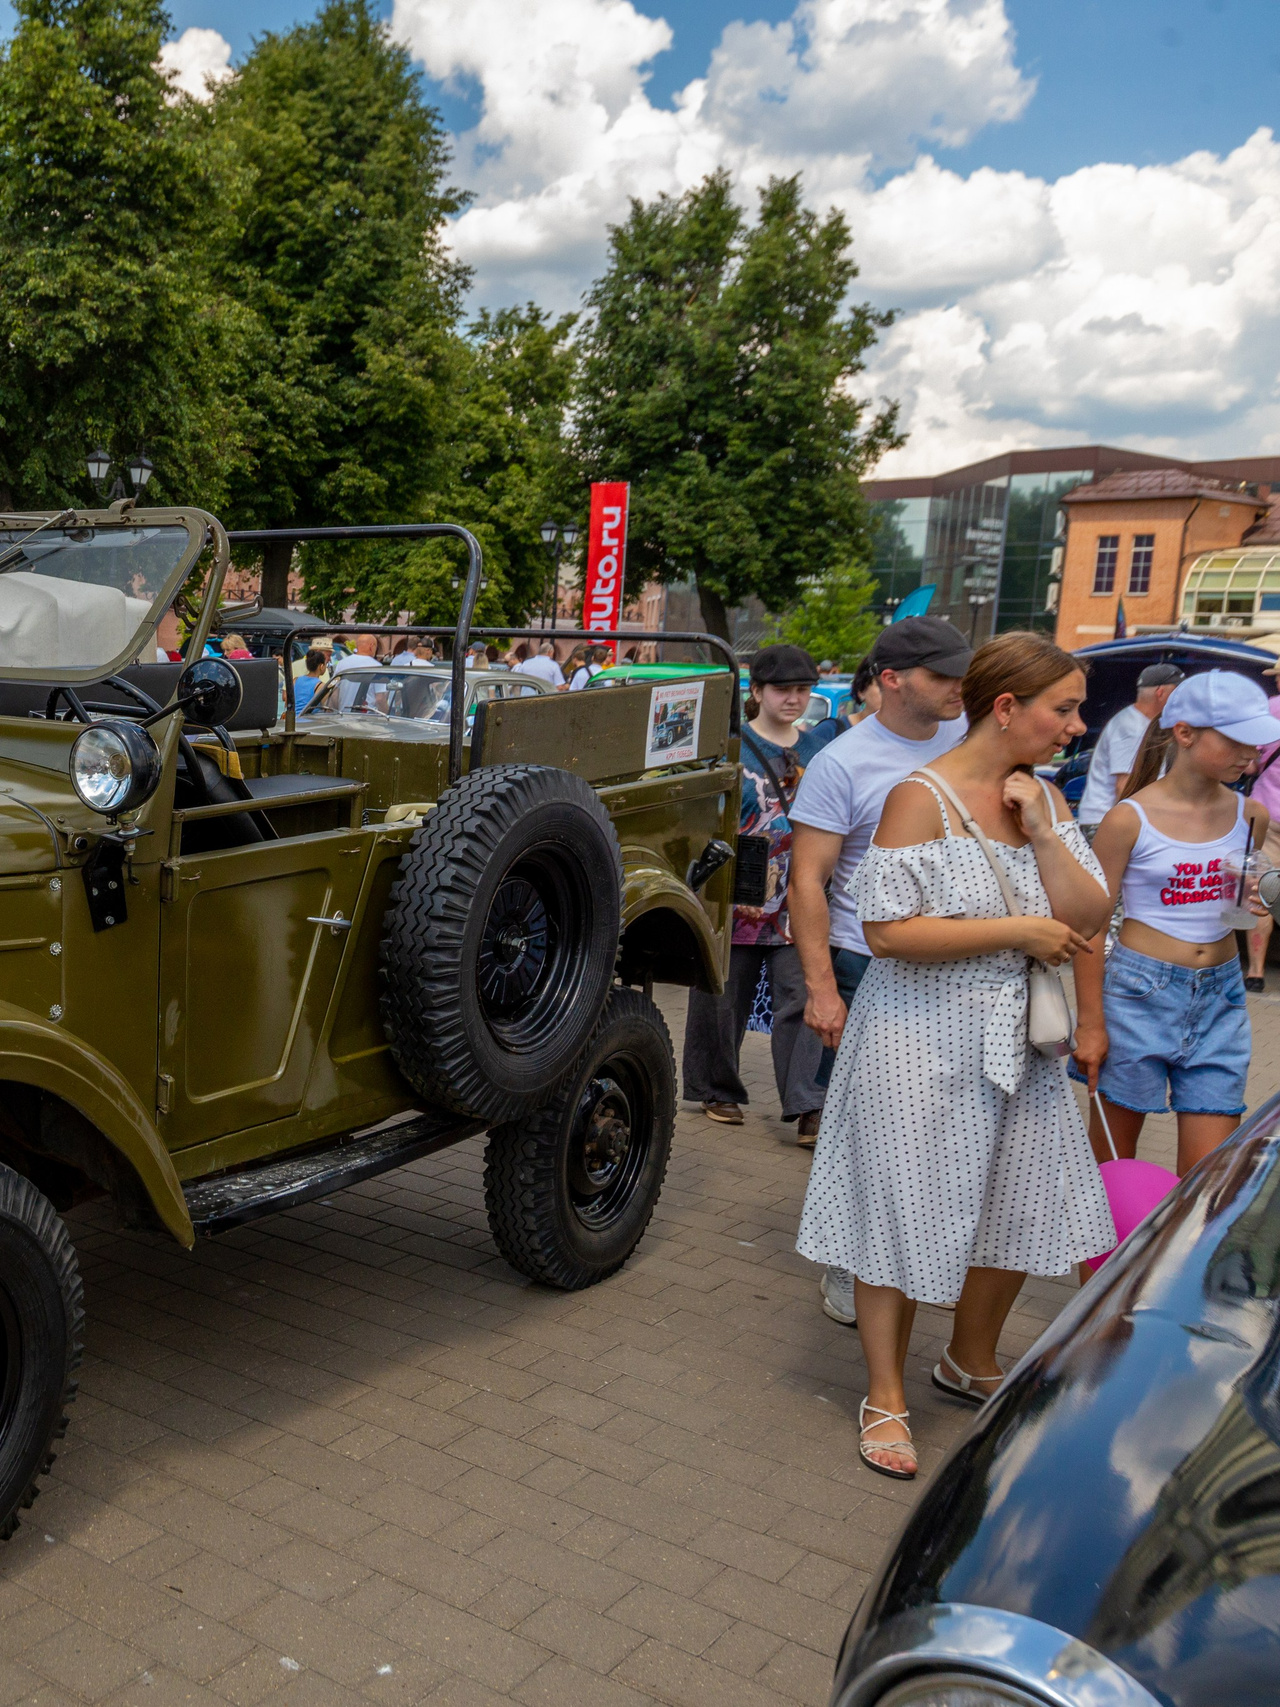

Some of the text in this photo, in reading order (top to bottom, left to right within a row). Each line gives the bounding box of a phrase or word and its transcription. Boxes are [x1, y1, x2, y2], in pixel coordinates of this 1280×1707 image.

[589, 506, 622, 644] auto.ru
[1173, 862, 1203, 876] YOU
[1167, 876, 1196, 889] THE
